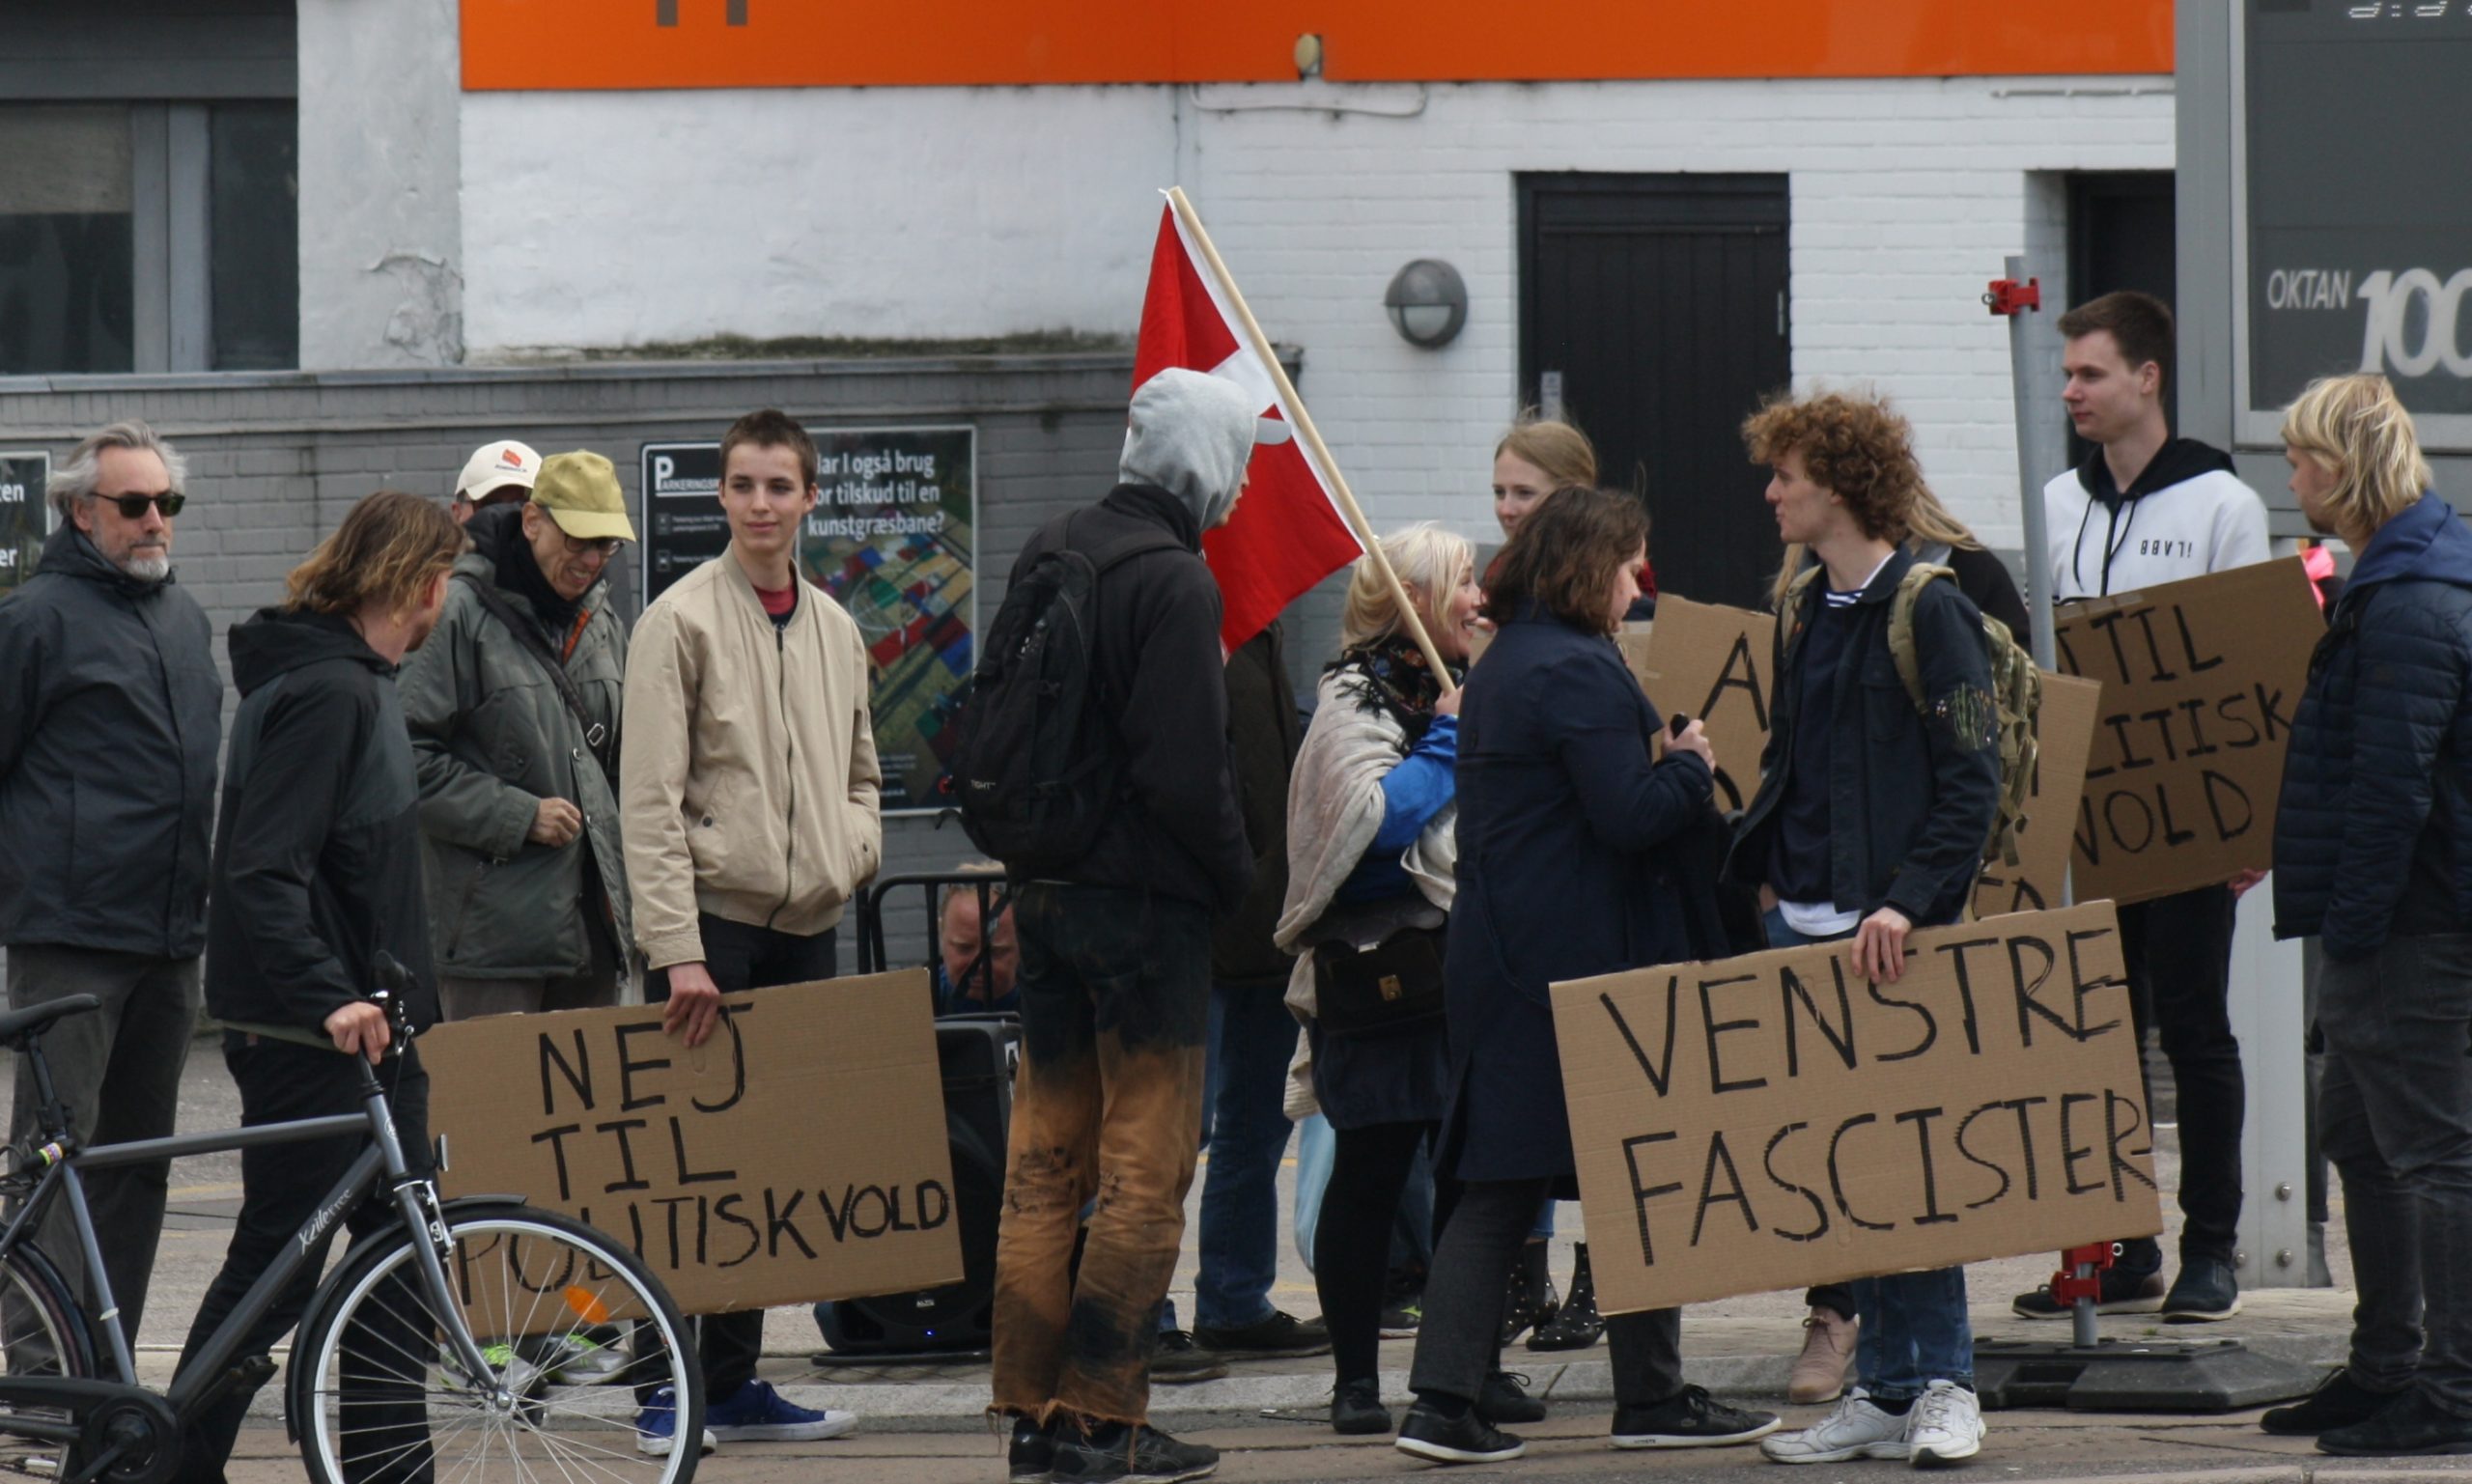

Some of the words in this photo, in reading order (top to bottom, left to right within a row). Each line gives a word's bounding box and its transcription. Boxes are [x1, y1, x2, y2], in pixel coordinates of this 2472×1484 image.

[2266, 269, 2350, 309] OKTAN
[836, 481, 894, 505] tilskud
[897, 481, 915, 503] til
[918, 485, 940, 503] en
[853, 449, 891, 480] også
[895, 450, 935, 479] brug
[807, 511, 944, 542] kunstgræsbane?
[2090, 604, 2224, 685] TIL
[1598, 927, 2124, 1098] VENSTRE
[539, 1001, 754, 1115] NEJ
[532, 1116, 737, 1201] TIL
[1621, 1088, 2157, 1267] FASCISTER
